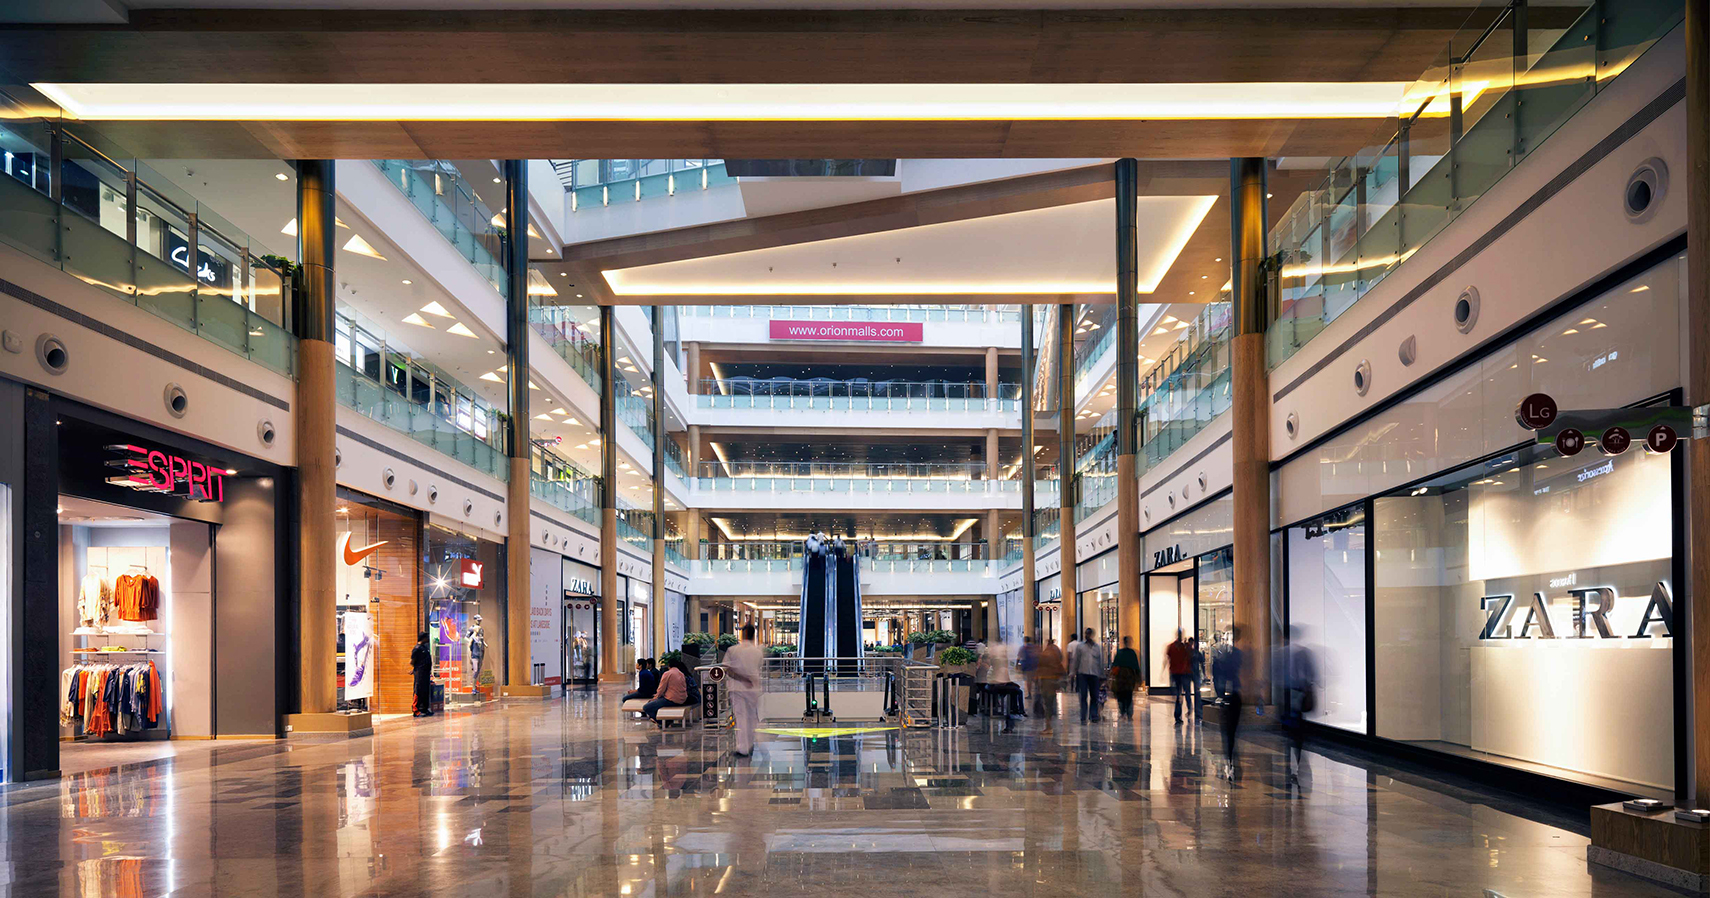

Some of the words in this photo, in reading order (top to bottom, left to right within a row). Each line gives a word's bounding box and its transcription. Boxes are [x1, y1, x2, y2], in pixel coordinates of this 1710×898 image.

[788, 325, 904, 337] www.orionmalls.com
[1655, 432, 1667, 447] P
[127, 444, 229, 502] ESPRIT
[1153, 543, 1182, 570] ZARA
[570, 577, 594, 596] ZARA
[1479, 581, 1674, 640] ZARA
